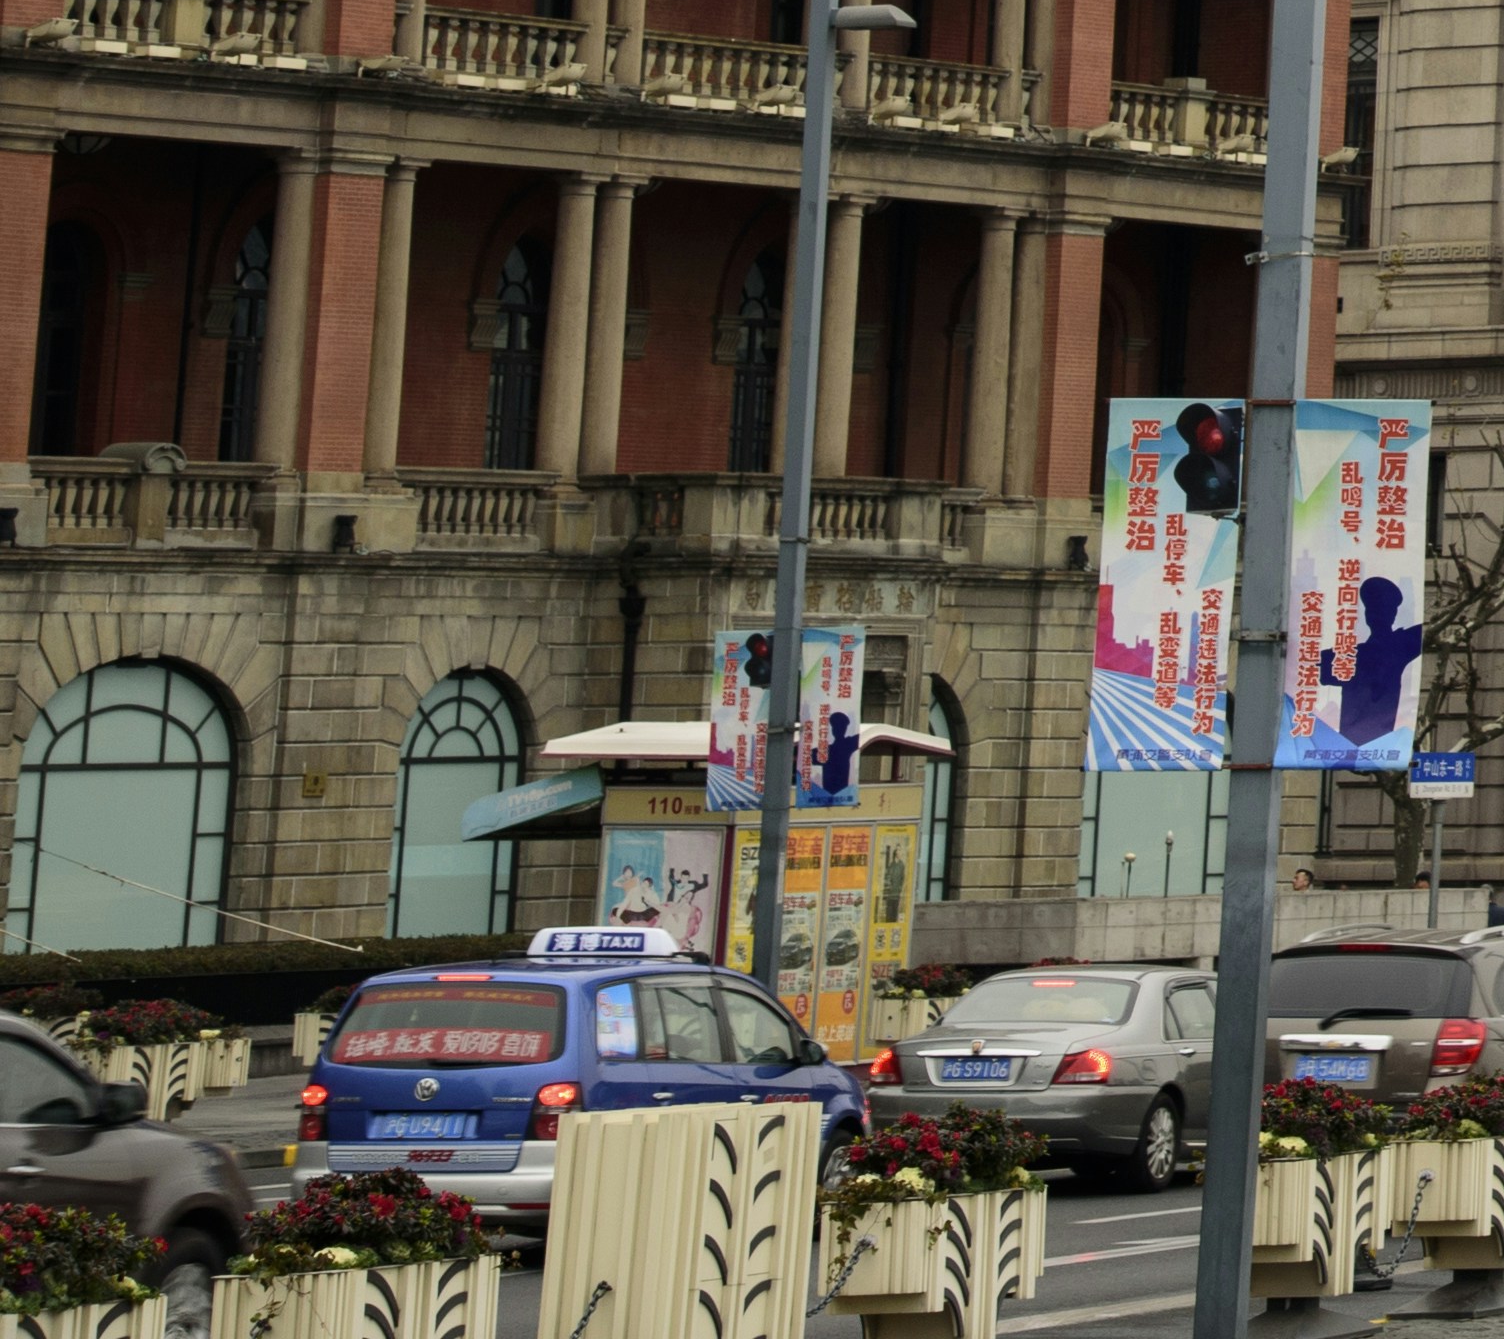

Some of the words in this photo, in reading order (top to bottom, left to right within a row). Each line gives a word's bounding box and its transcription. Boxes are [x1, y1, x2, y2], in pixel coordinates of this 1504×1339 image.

[1125, 419, 1162, 552] 严厉整治
[1375, 419, 1409, 550] 严厉整治
[1191, 588, 1223, 735] 交通违法行为
[1290, 591, 1324, 737] 交通违法行为
[648, 797, 682, 814] 110
